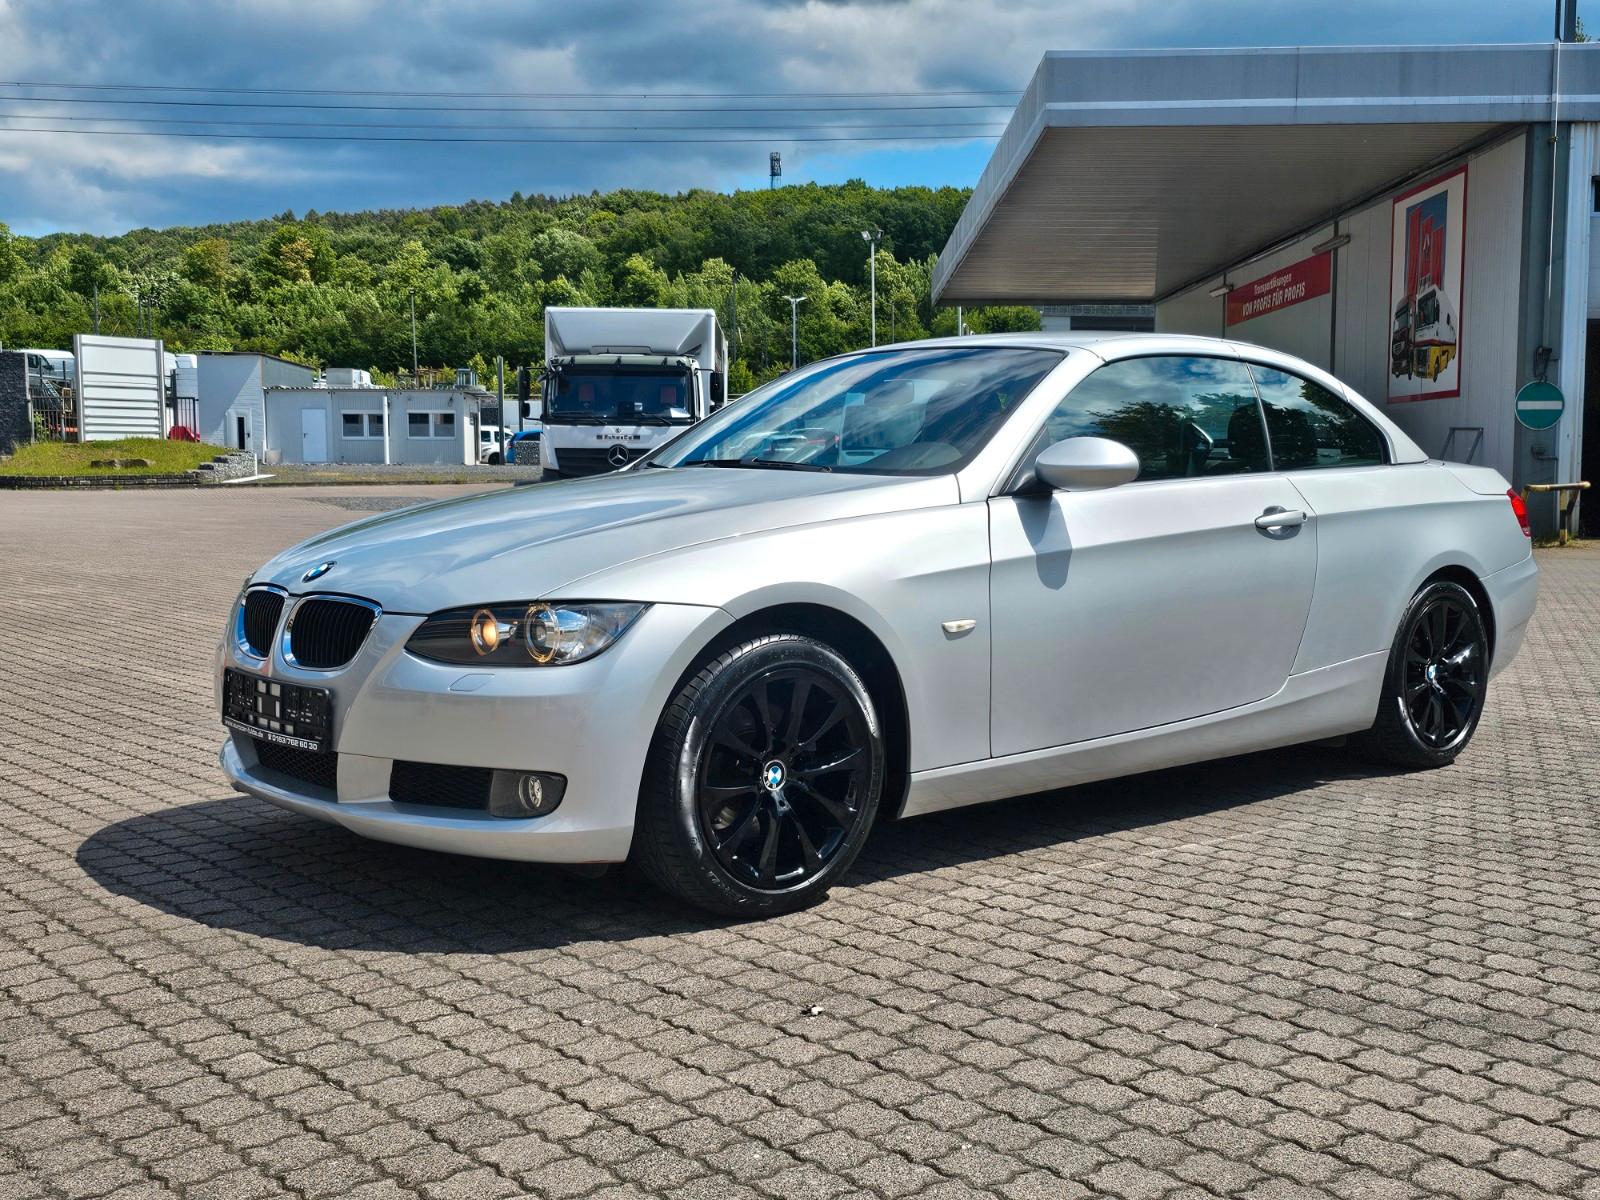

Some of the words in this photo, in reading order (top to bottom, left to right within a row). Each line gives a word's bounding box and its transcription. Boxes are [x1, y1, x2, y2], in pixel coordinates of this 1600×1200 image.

[1242, 302, 1253, 317] VON
[1253, 294, 1271, 312] PROFIS
[1272, 288, 1284, 307] FÜR
[1284, 281, 1306, 302] PROFIS
